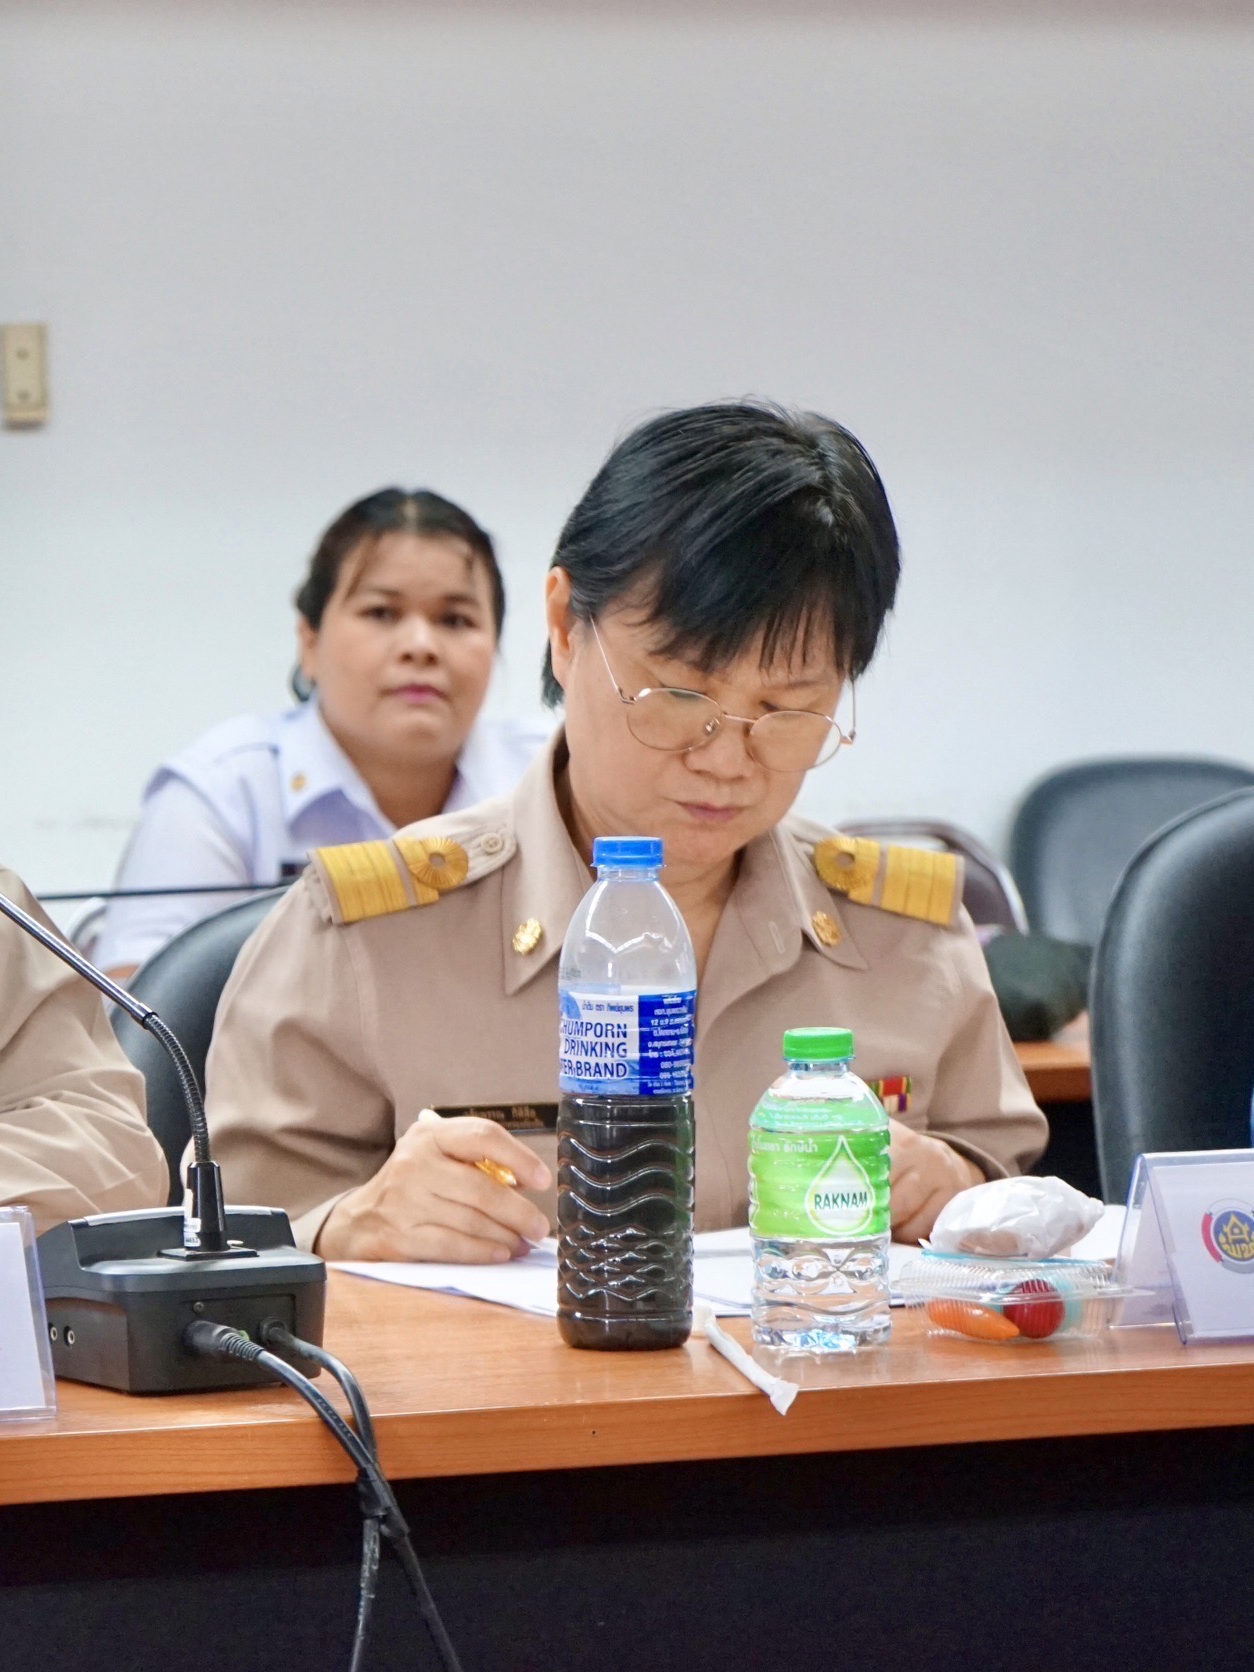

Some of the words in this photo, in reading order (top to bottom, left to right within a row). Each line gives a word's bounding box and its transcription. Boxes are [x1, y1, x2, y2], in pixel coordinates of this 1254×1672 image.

[561, 1019, 628, 1039] HUMPORN
[564, 1037, 628, 1058] DRINKING
[575, 1060, 628, 1078] BRAND
[814, 1192, 868, 1210] RAKNAM
